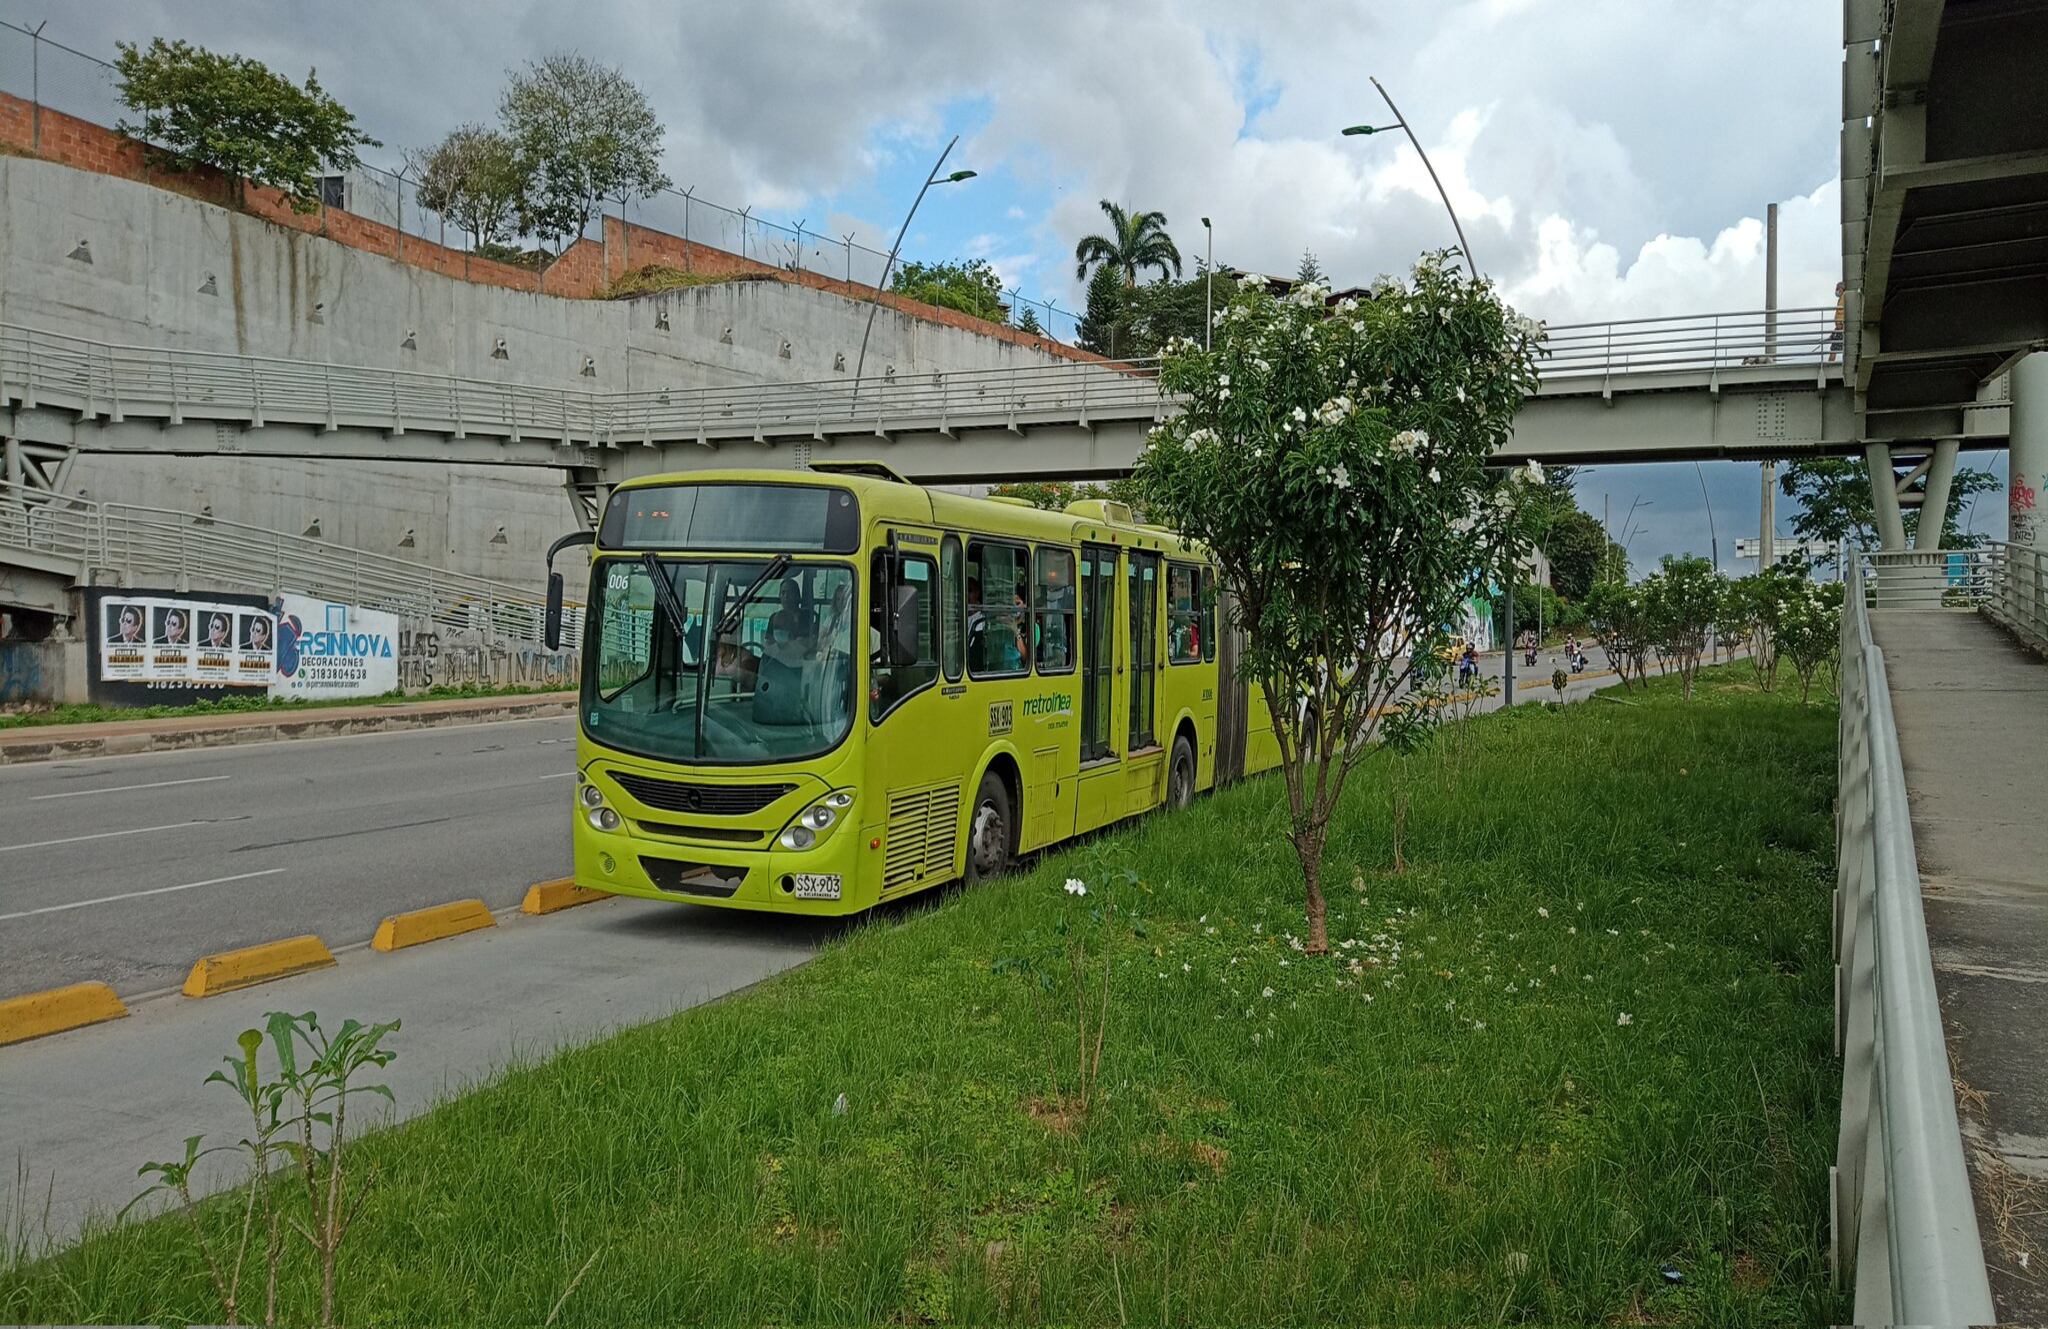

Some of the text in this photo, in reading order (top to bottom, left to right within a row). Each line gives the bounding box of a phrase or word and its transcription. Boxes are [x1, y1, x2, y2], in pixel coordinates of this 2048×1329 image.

[609, 574, 628, 589] 006
[299, 631, 392, 657] RSINNOVA
[301, 657, 364, 667] DECORACIONES
[310, 668, 367, 680] 3183804638
